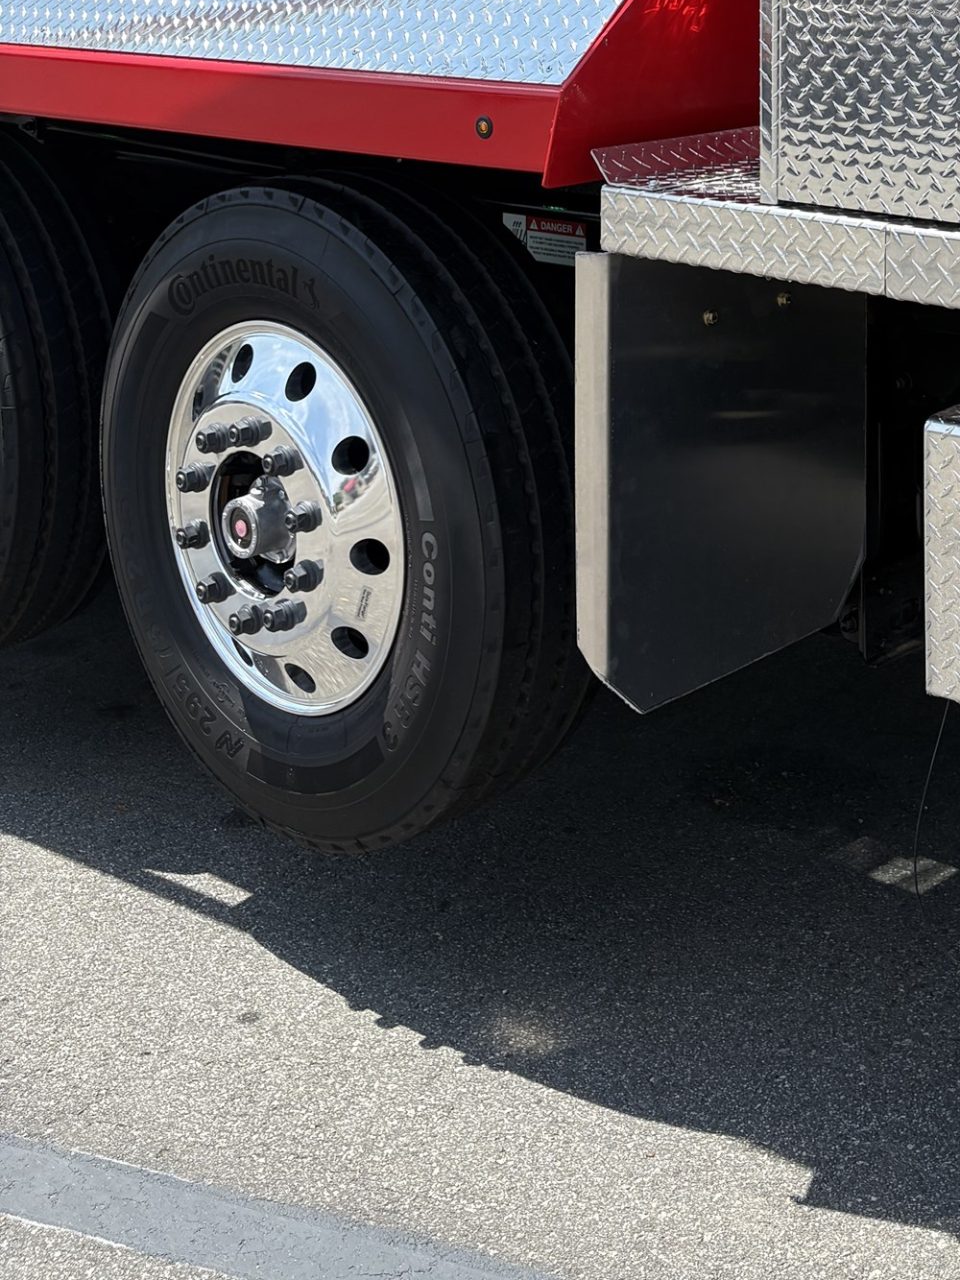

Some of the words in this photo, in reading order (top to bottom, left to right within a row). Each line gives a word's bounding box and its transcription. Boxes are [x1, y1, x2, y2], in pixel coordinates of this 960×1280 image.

[540, 222, 573, 233] DANGER
[167, 253, 299, 316] Continental
[419, 530, 440, 647] Conti
